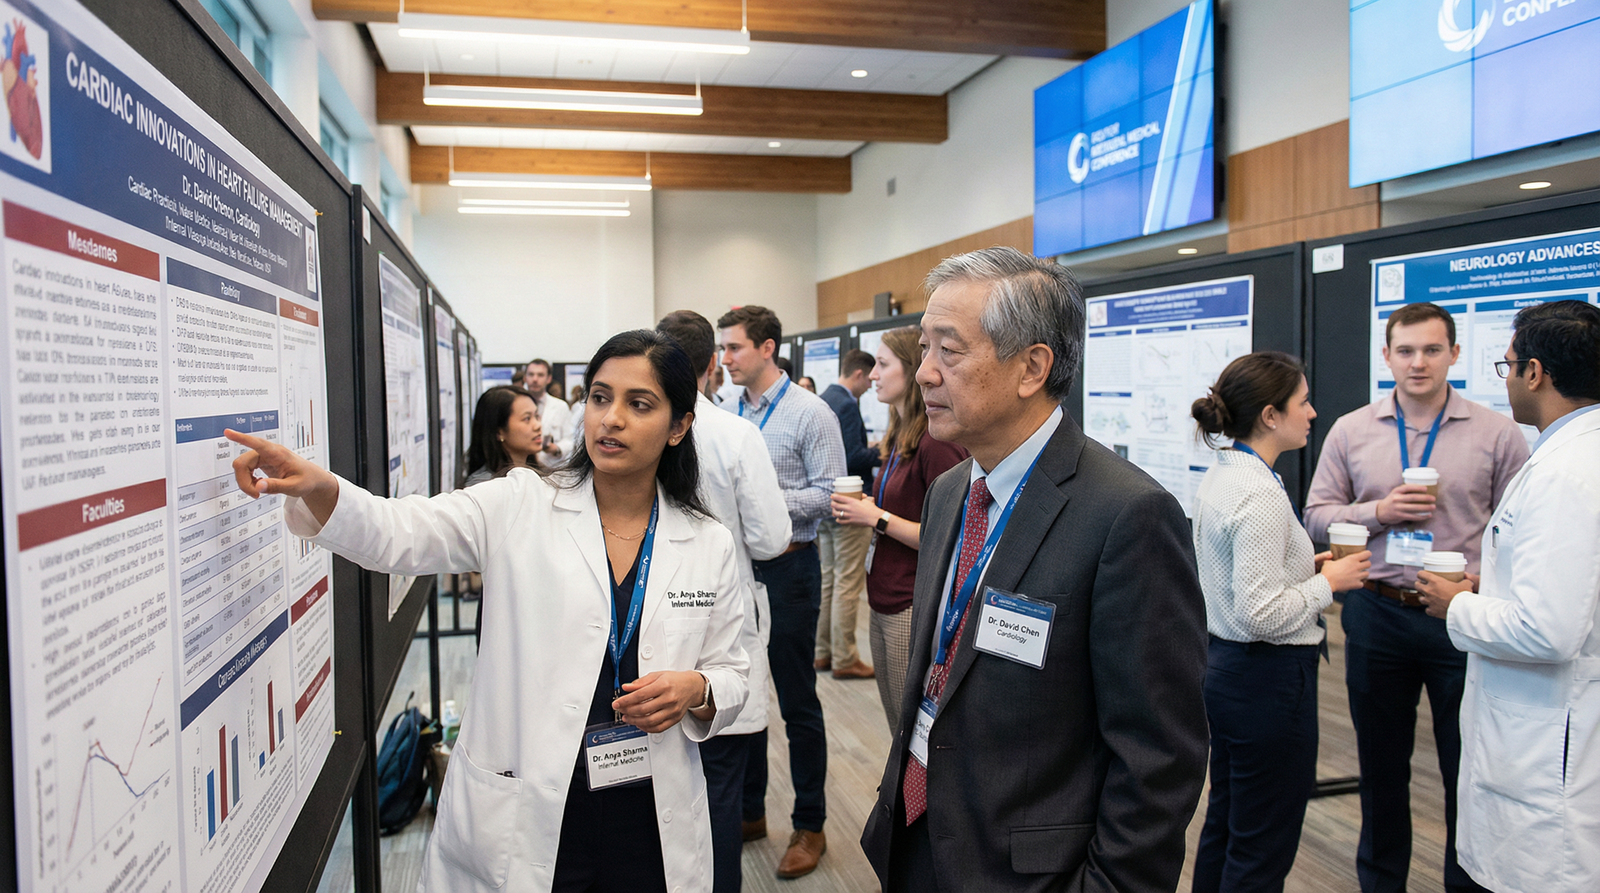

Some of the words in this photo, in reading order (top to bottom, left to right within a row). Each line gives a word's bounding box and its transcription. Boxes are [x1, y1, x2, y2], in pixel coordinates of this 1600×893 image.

[66, 51, 133, 125] CARDIAC
[136, 100, 206, 174] INNOVATIONS
[206, 152, 216, 181] IN
[217, 159, 242, 198] HEART
[243, 179, 269, 217] FAILURE
[269, 199, 303, 240] MANAGEMENT
[1090, 143, 1140, 172] CONFERENCE
[128, 175, 152, 201] Cardiac
[182, 174, 193, 198] Dr.
[193, 181, 213, 209] David
[67, 229, 118, 263] Mesdames
[1449, 250, 1526, 273] NEUROLOGY
[1526, 241, 1600, 263] ADVANCES
[82, 497, 125, 524] Faculties
[667, 591, 679, 599] Dr.
[680, 590, 695, 600] Anya
[671, 600, 694, 608] Internal
[988, 616, 998, 626] Dr.
[999, 619, 1020, 632] David
[1020, 625, 1040, 637] Chen
[996, 629, 1027, 645] Cardiology
[592, 755, 604, 763] Dr.
[604, 751, 621, 760] Anya
[622, 746, 648, 757] Sharma
